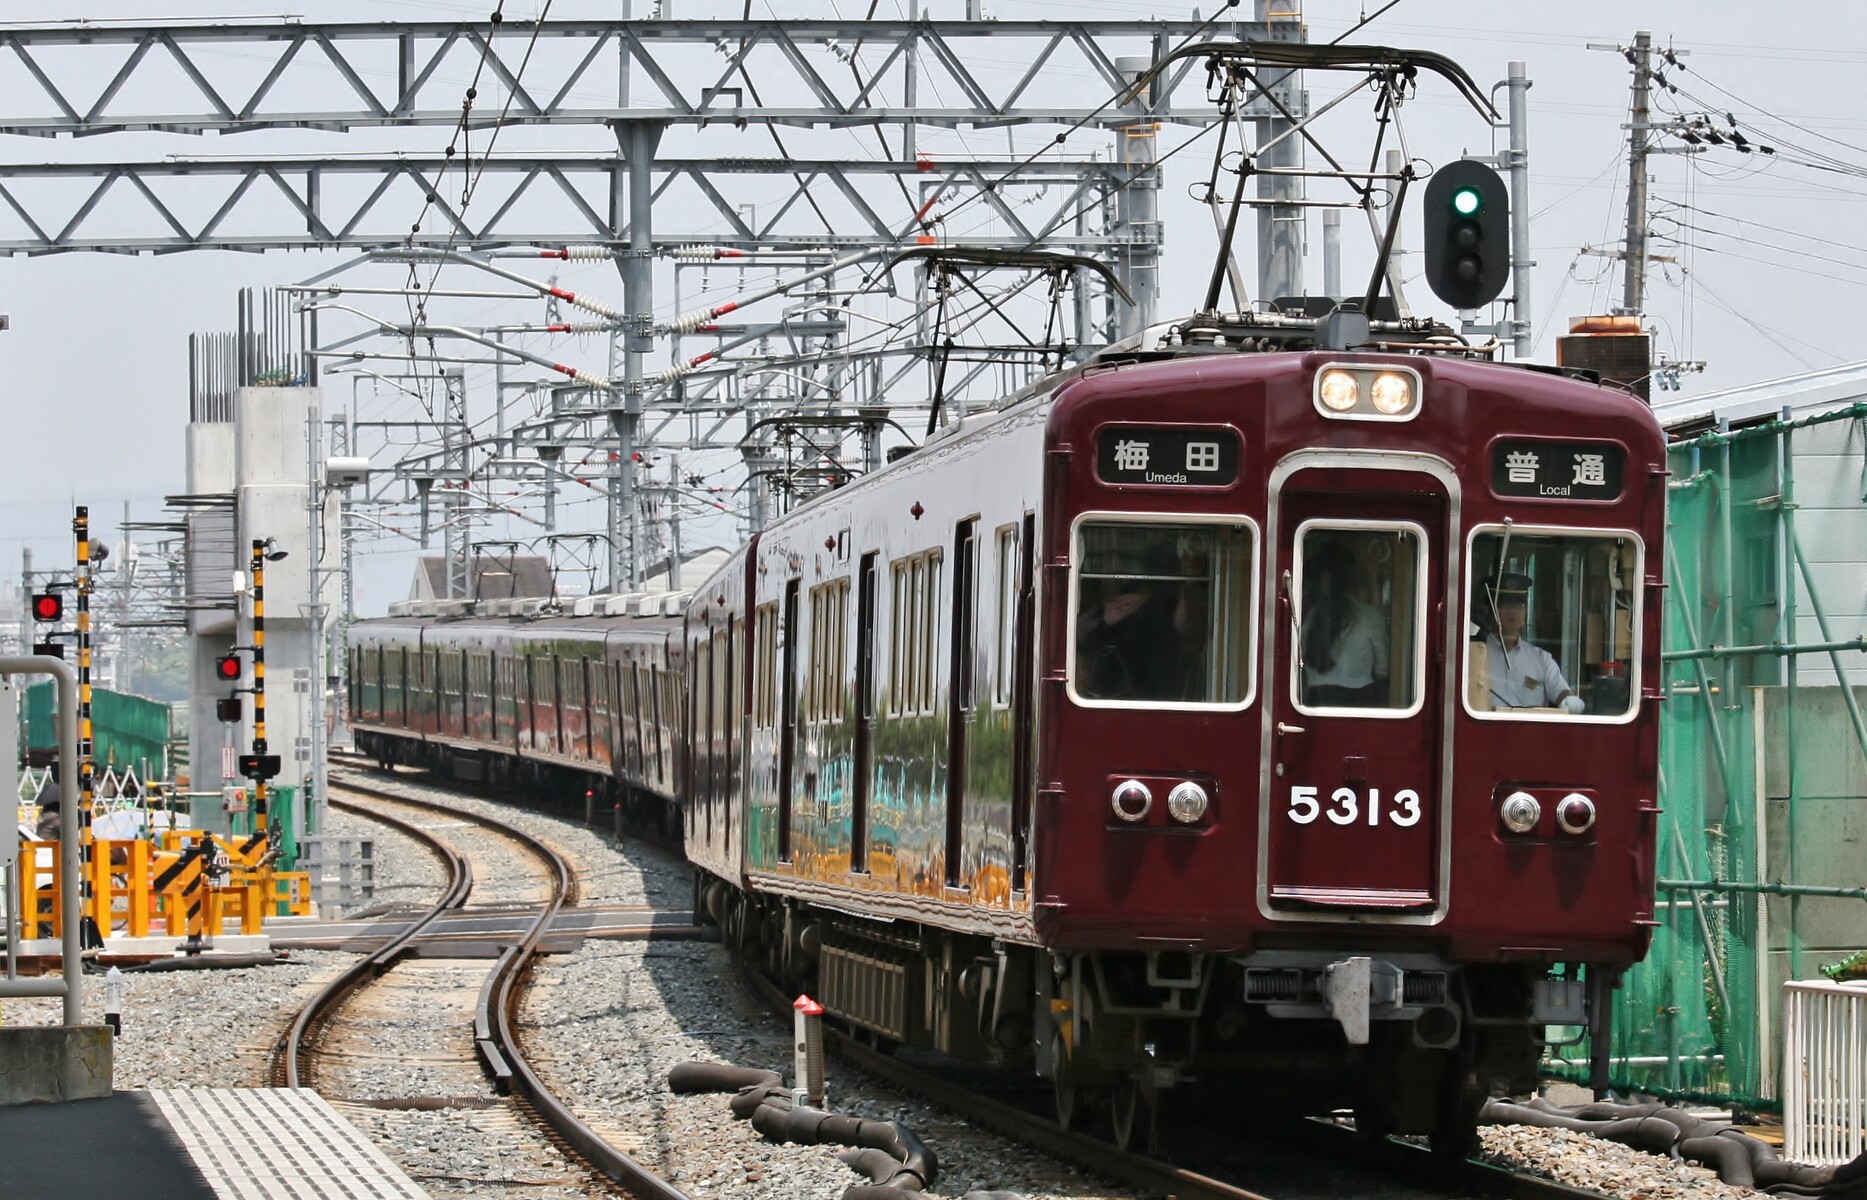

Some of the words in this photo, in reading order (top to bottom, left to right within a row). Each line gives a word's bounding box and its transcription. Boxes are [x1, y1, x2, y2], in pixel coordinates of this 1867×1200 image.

[1114, 440, 1219, 471] 梅田
[1505, 451, 1605, 485] 普通
[1145, 472, 1187, 483] Umeda
[1540, 484, 1570, 495] Local
[1288, 786, 1421, 826] 5313
